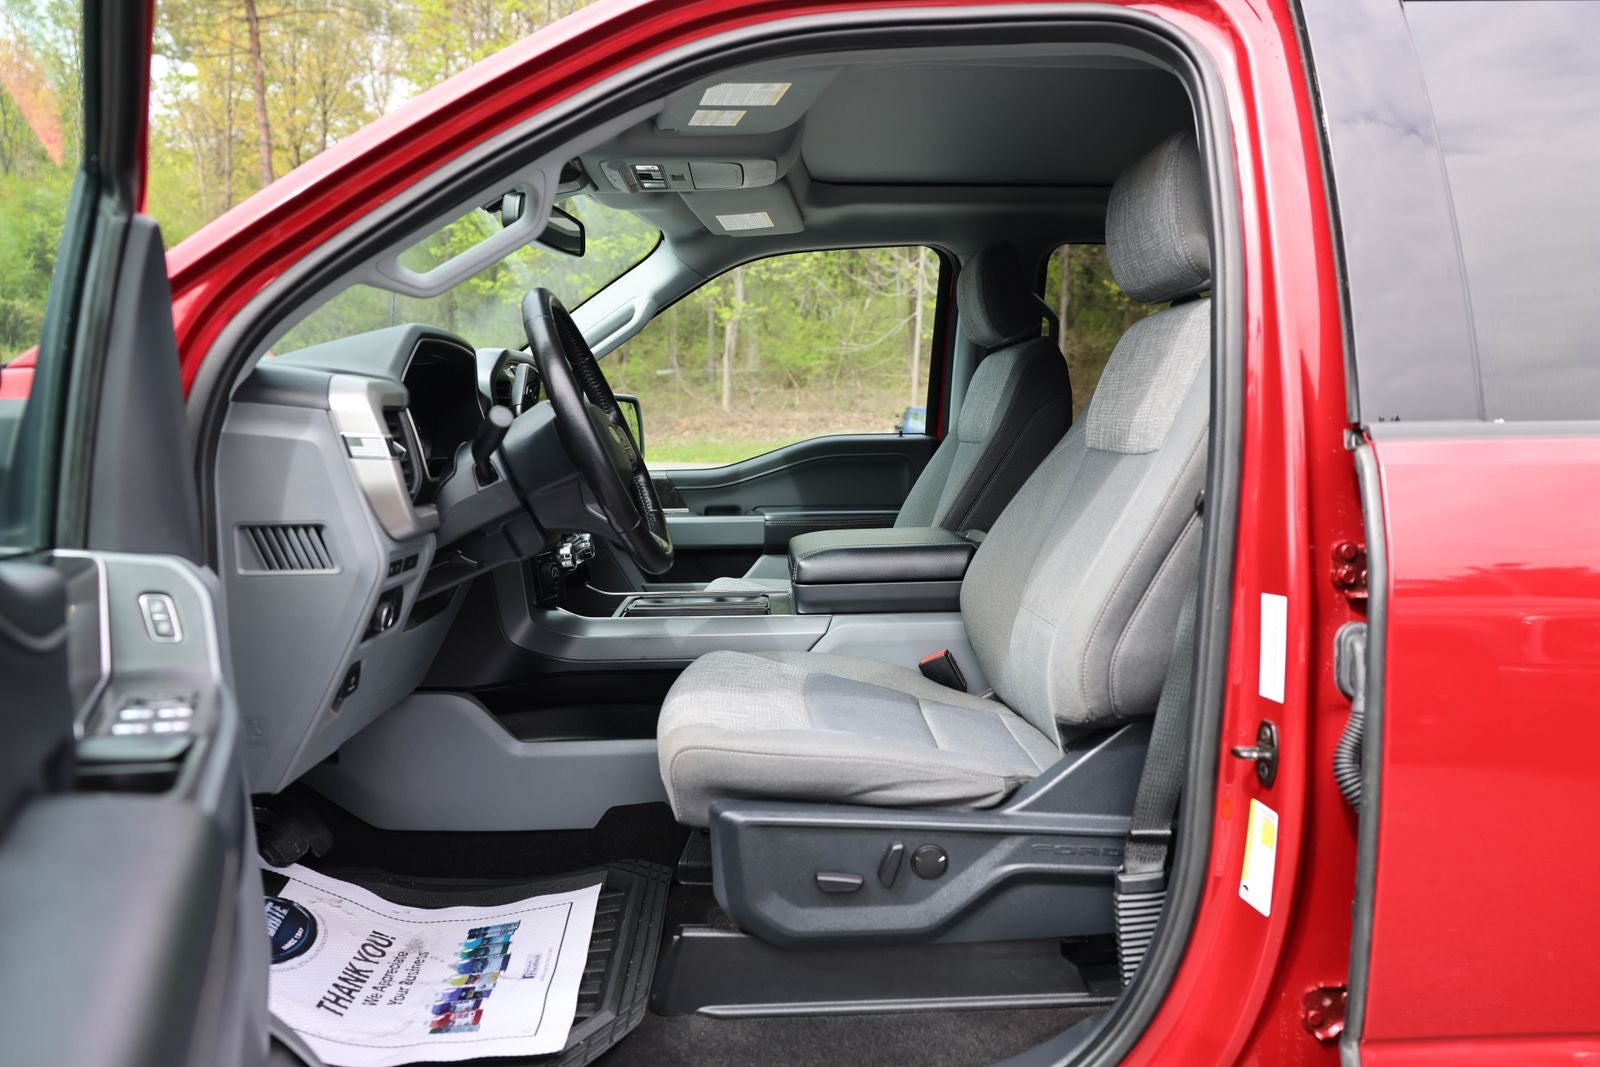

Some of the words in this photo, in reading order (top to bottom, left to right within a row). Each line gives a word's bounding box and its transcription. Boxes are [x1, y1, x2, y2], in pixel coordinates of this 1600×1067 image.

[1031, 843, 1123, 858] FORD
[316, 961, 374, 1017] THANK
[353, 930, 396, 965] YOU!
[361, 990, 383, 1006] We
[372, 951, 409, 993] Appreciate
[386, 986, 410, 1006] Your
[399, 951, 430, 986] Business
